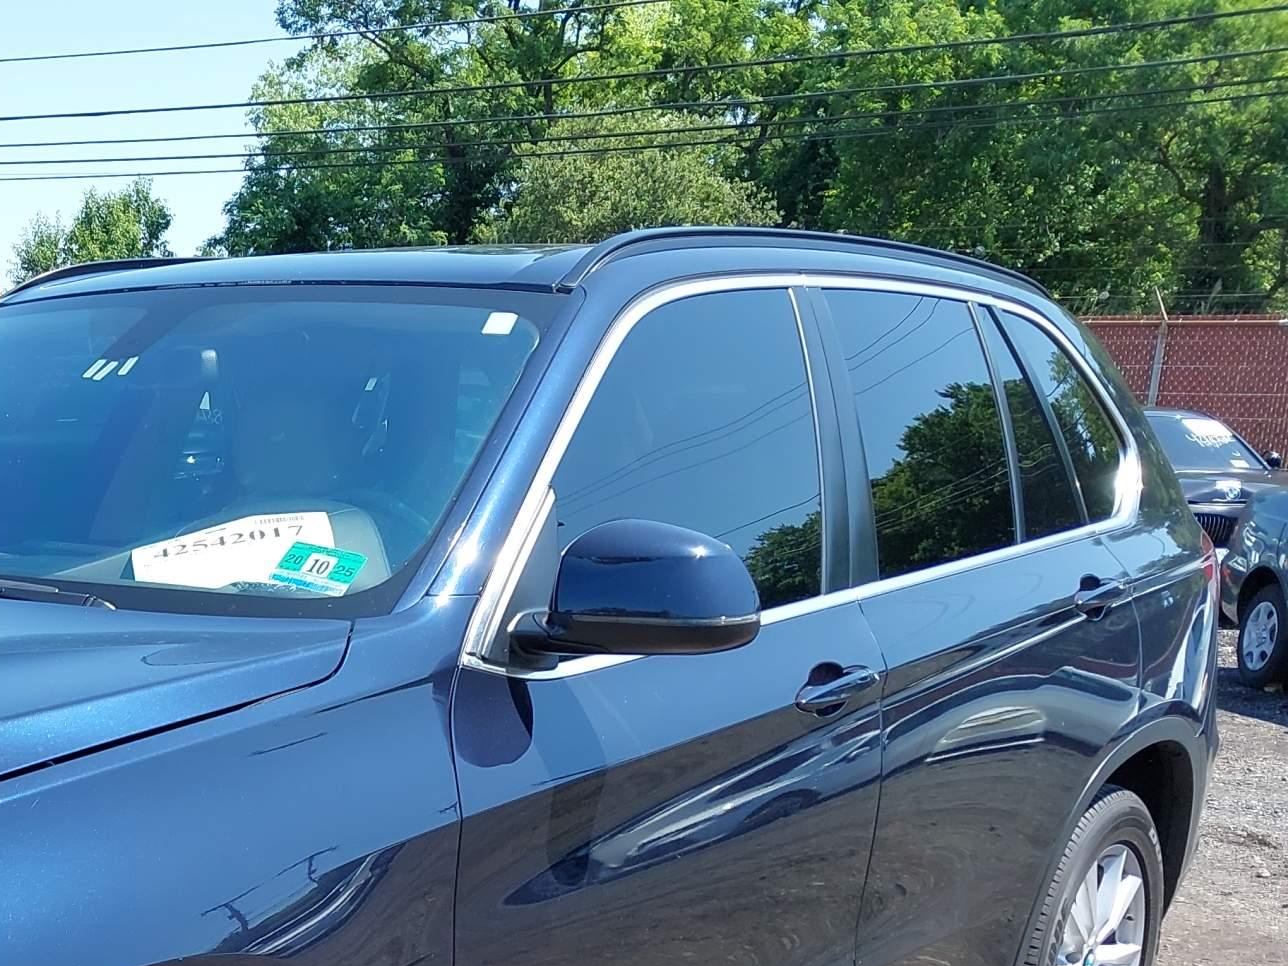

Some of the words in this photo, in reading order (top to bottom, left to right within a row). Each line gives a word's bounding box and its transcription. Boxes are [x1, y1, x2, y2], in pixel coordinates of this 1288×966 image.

[153, 524, 304, 559] 42542017
[285, 553, 304, 566] 20
[307, 558, 331, 576] 10
[334, 565, 355, 578] 25
